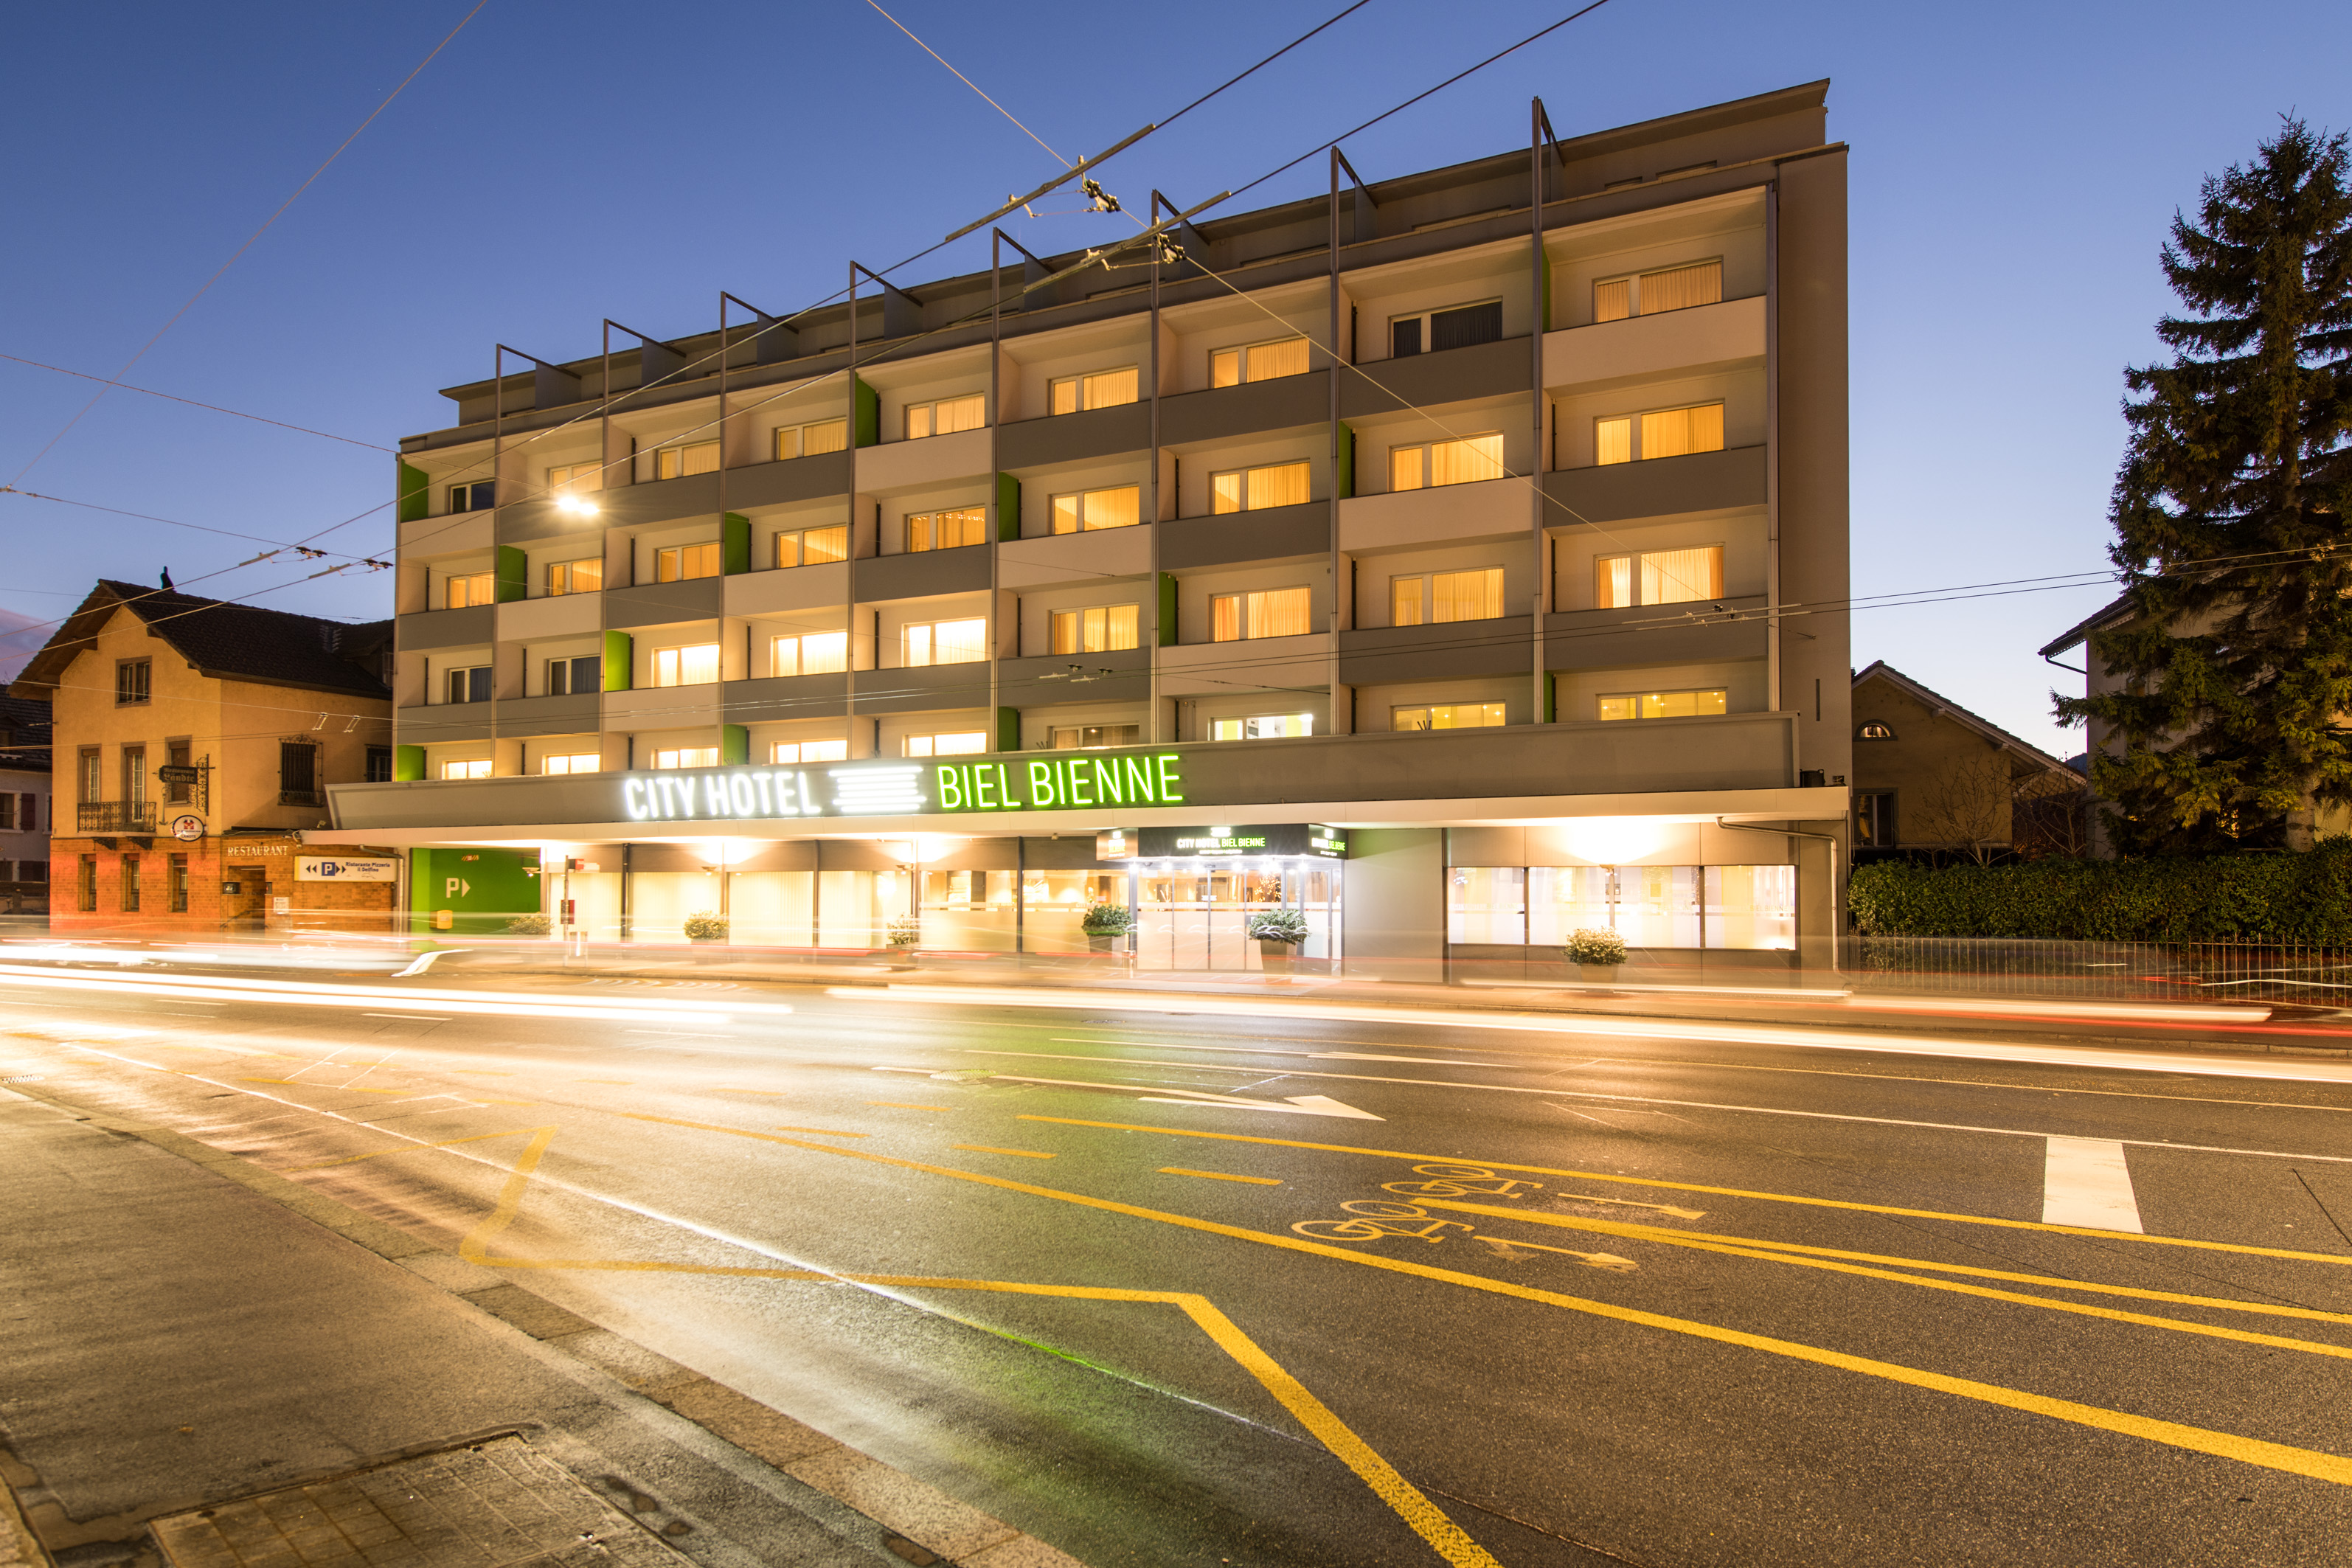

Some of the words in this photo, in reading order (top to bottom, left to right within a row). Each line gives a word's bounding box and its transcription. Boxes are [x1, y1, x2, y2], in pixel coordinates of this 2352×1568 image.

[625, 777, 695, 819] CITY
[706, 772, 822, 816] HOTEL
[937, 764, 1021, 808] BIEL
[1029, 755, 1183, 805] BIENNE
[1176, 838, 1195, 848] CITY
[1221, 838, 1238, 847] BIEL
[1238, 838, 1266, 847] BIENNE
[227, 845, 288, 856] RESTAURANT
[325, 864, 333, 875] P
[445, 878, 459, 898] P
